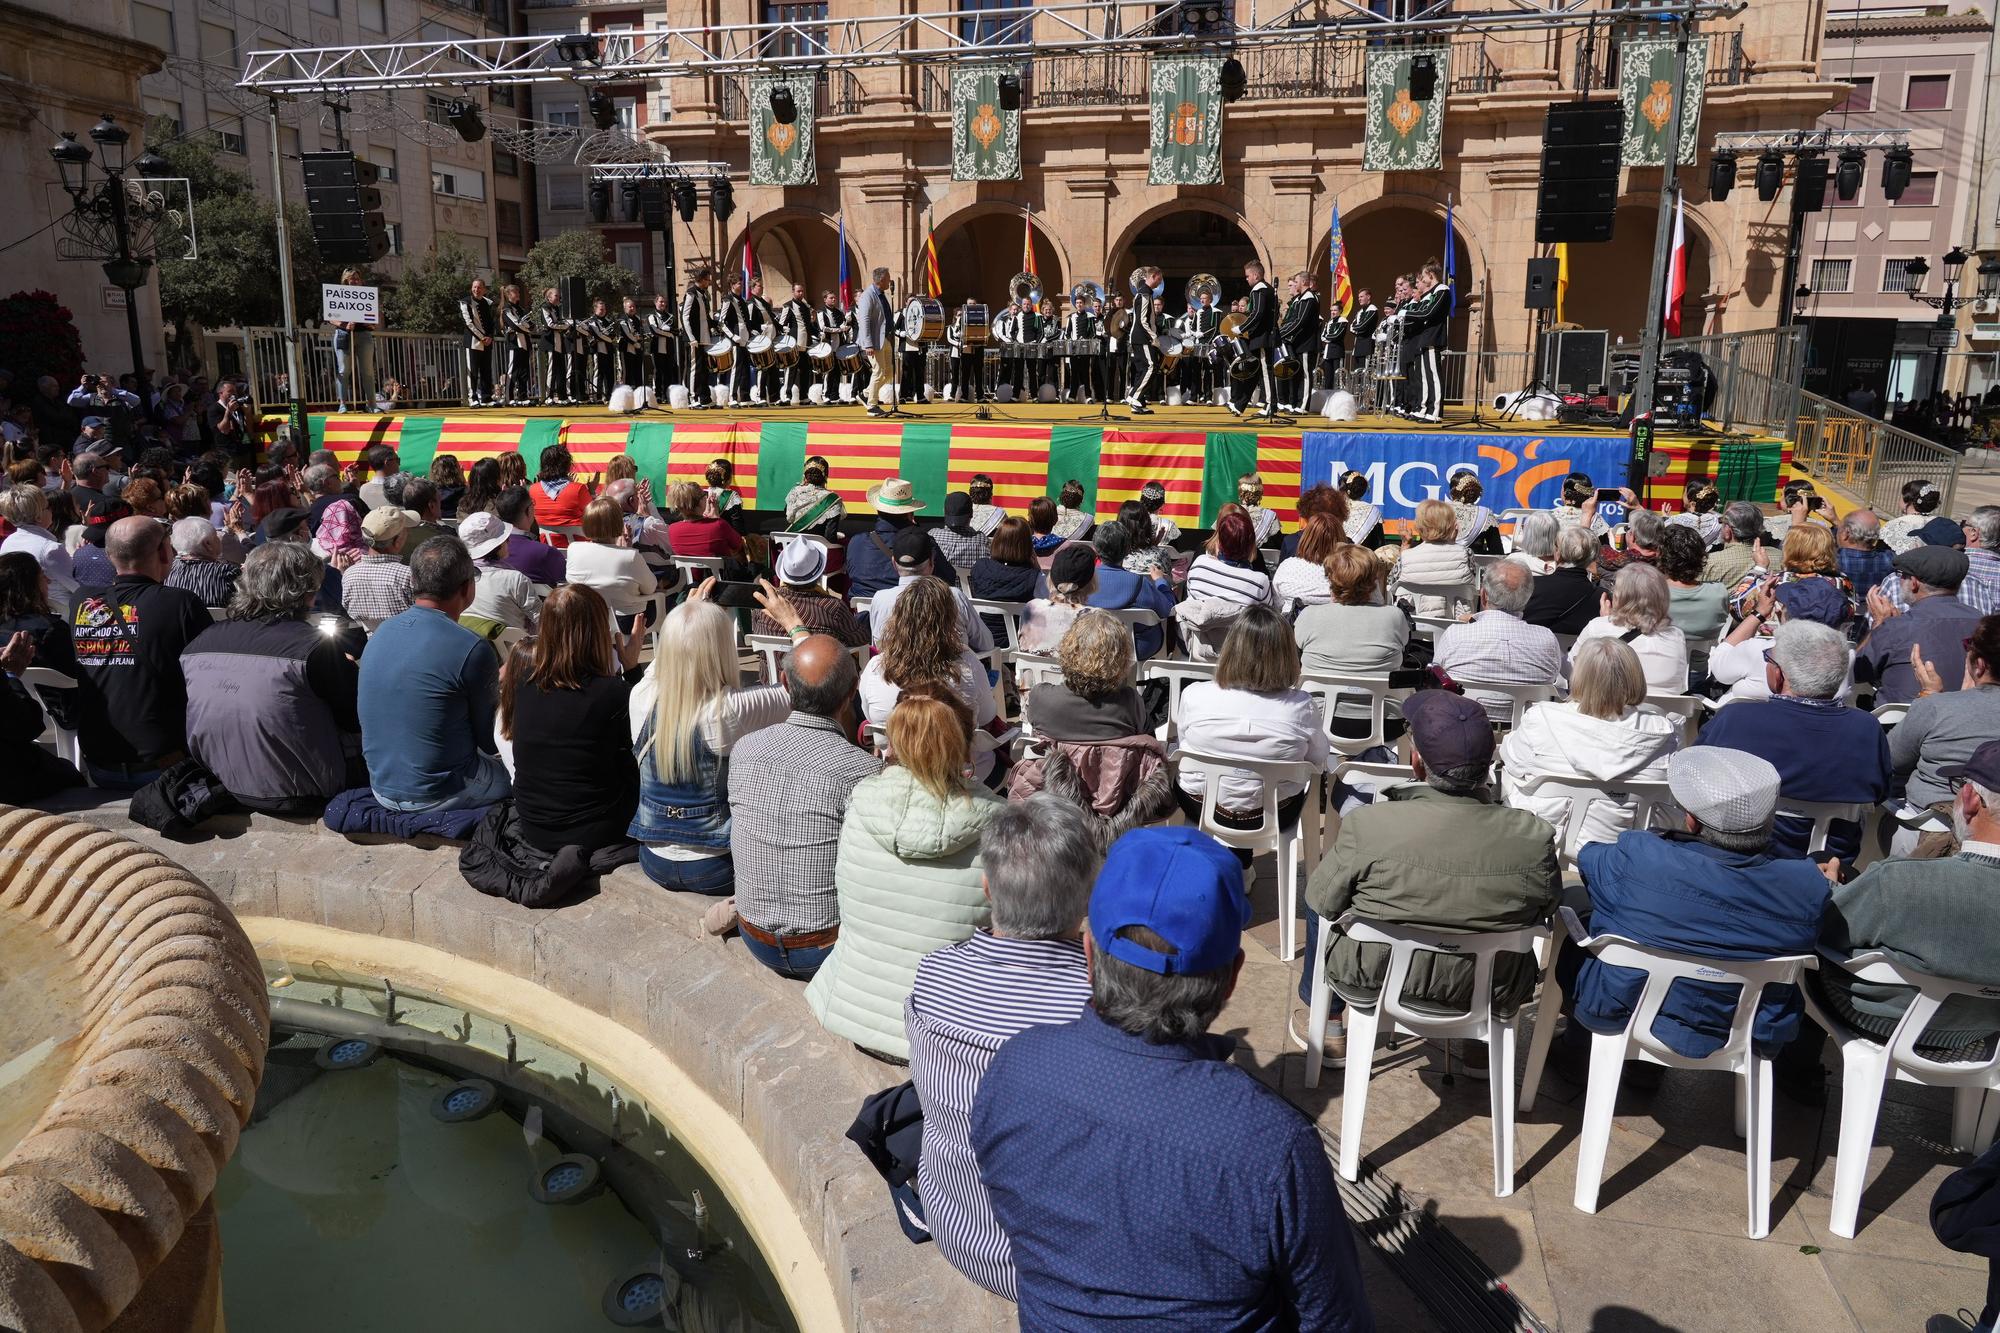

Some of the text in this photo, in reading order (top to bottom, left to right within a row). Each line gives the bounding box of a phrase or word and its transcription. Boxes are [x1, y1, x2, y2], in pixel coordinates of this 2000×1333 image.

[326, 288, 375, 300] PAÏSSOS
[329, 301, 373, 311] BAIXOS
[1637, 437, 1647, 461] kuzar
[115, 657, 135, 666] PLANA
